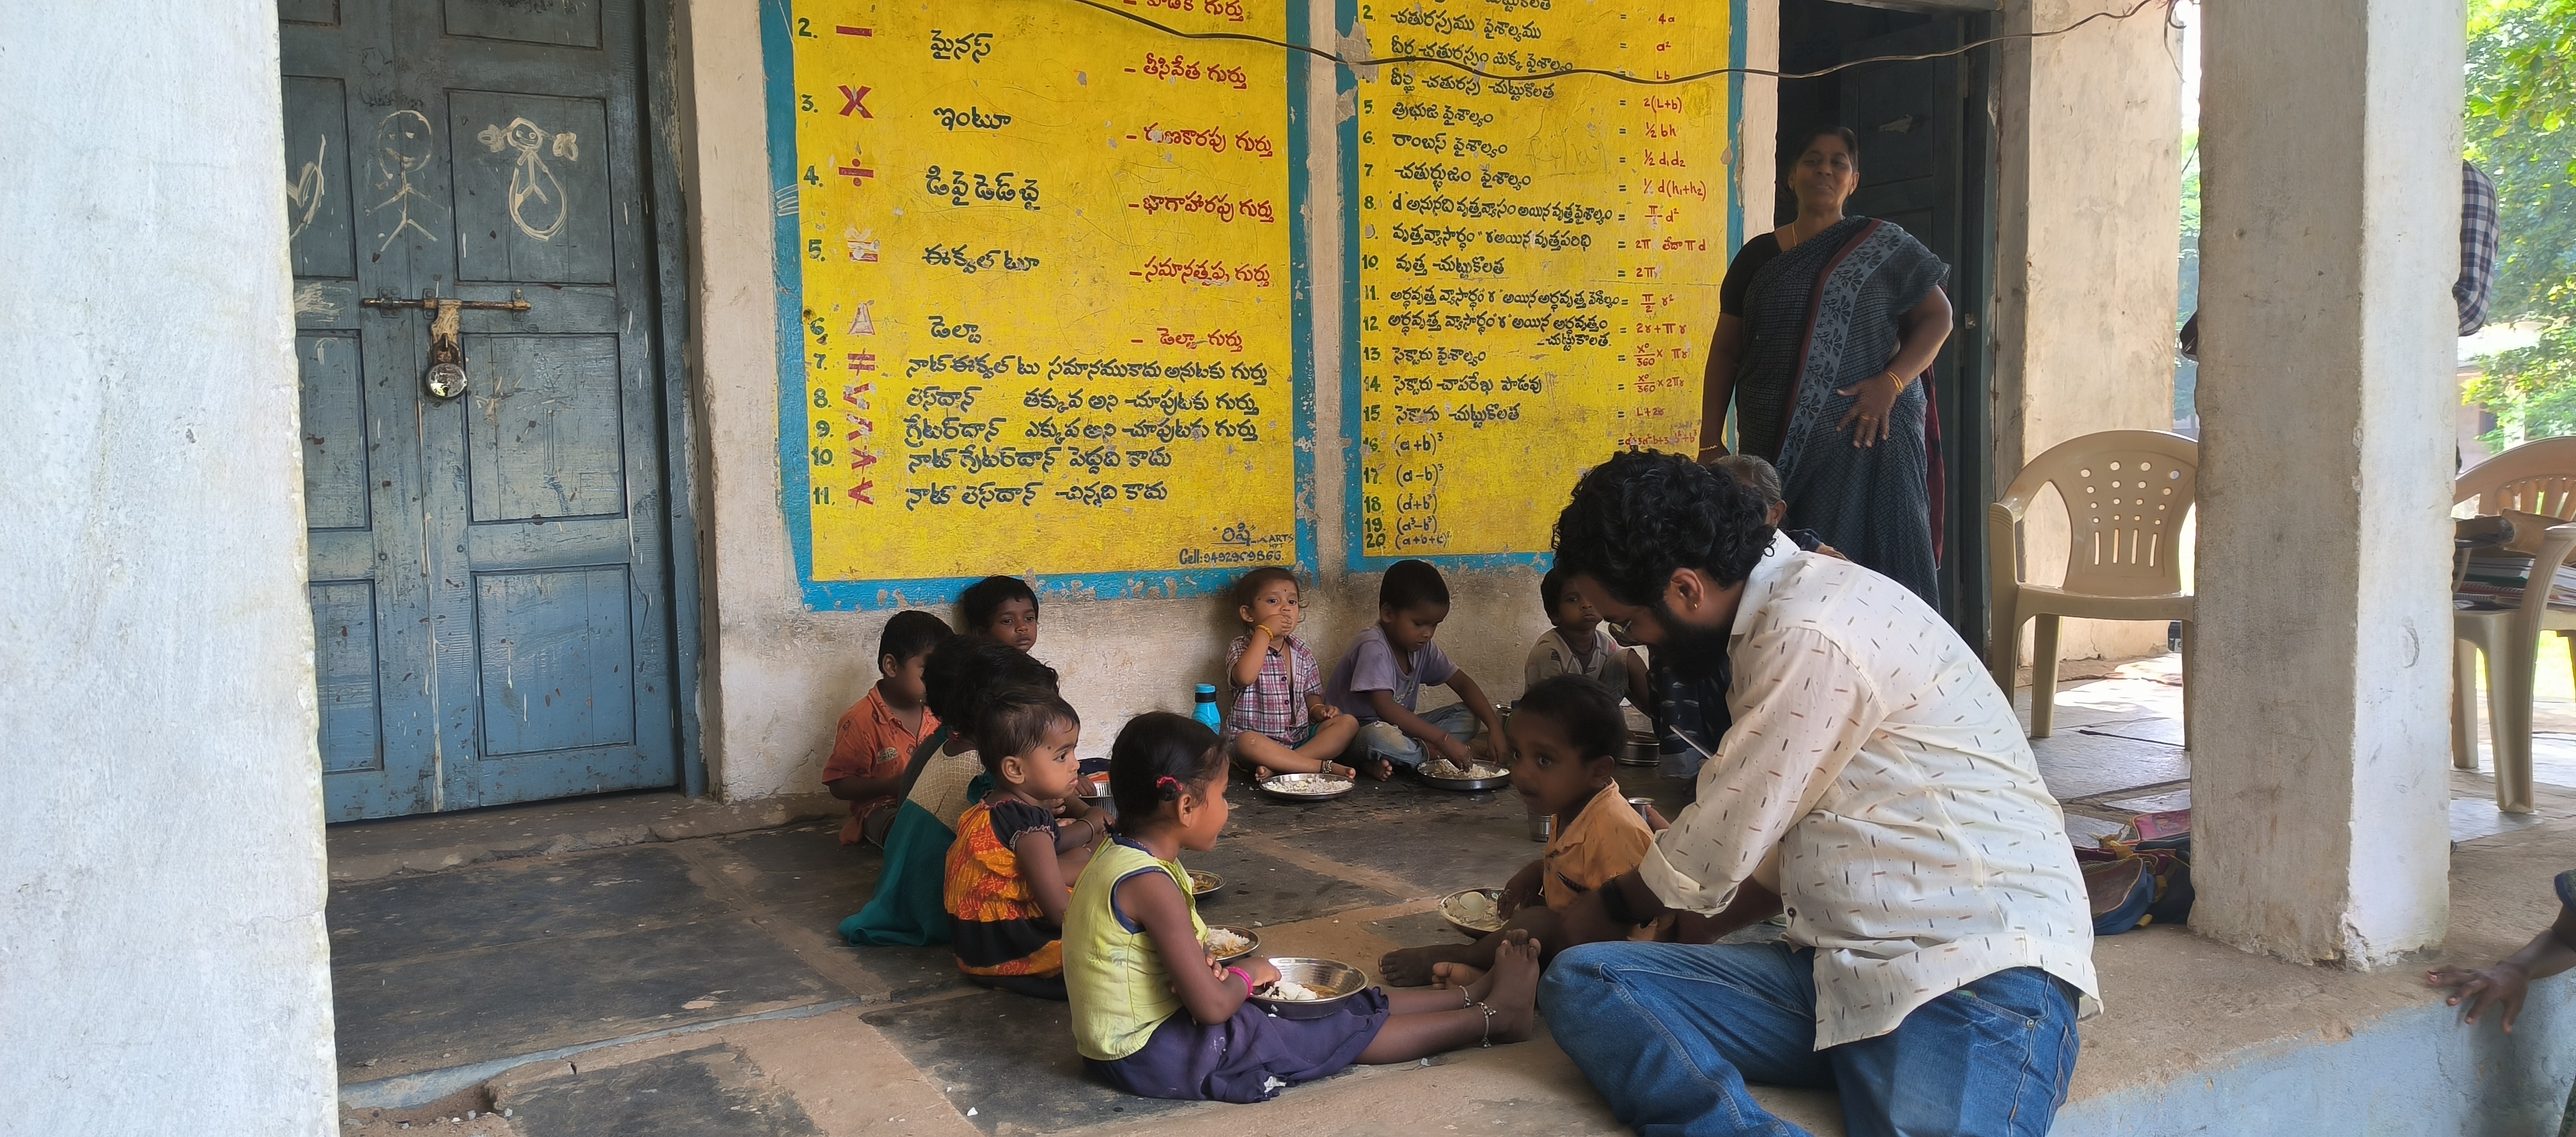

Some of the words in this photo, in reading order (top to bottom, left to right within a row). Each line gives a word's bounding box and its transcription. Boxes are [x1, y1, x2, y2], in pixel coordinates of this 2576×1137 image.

[931, 30, 993, 63] మైనస్
[1143, 53, 1201, 80] తీసివేత
[1206, 64, 1247, 89] గుర్తు
[1443, 105, 1494, 127] వైశాల్యం
[1235, 130, 1273, 157] గుర్తు
[1392, 133, 1446, 154] రాంబస్
[1453, 138, 1508, 158] వైశాల్యం
[1481, 169, 1531, 190] వైశాల్యం
[1239, 199, 1274, 223] గుర్తు
[1235, 264, 1270, 287] గుర్తు
[1396, 254, 1427, 275] వృత్త
[1433, 255, 1505, 279] చుట్టుకొలత
[1208, 329, 1242, 353] గుర్తు
[1231, 361, 1267, 386] గుర్తు
[1023, 387, 1084, 413] తక్కువ
[1088, 395, 1119, 412] అని
[1216, 392, 1260, 415] గుర్తు
[1215, 419, 1258, 441] గుర్తు
[1126, 446, 1171, 467] కాదు
[1122, 481, 1168, 500] కాదు
